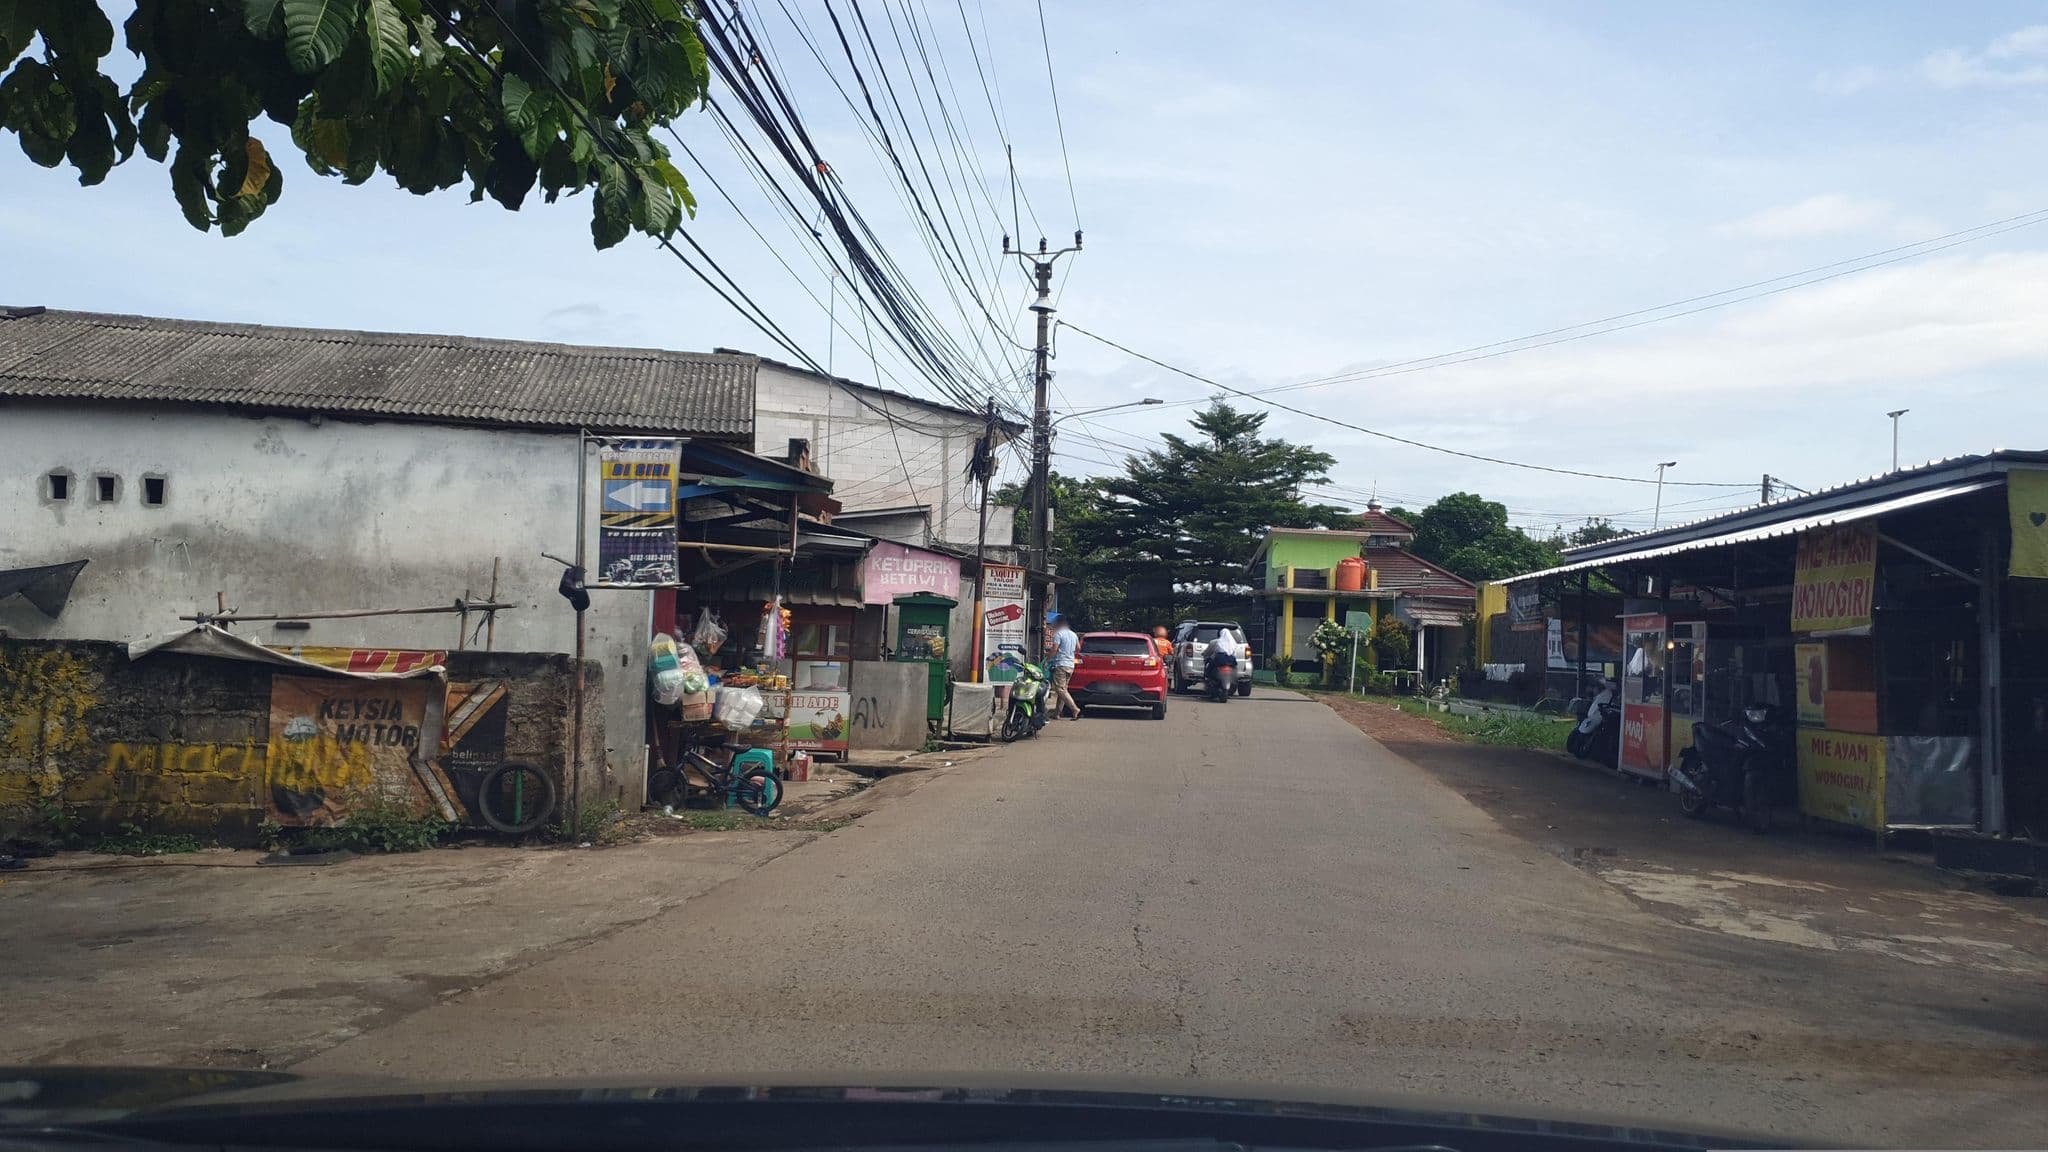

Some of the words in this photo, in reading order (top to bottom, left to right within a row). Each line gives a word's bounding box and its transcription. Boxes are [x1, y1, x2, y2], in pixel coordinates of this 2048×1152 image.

[871, 557, 953, 575] KETOPRAK
[880, 573, 936, 586] BETAWI
[1795, 577, 1871, 619] WONOGIRI
[319, 699, 403, 721] KEYSIA
[773, 696, 804, 708] TH
[807, 697, 839, 709] ADE
[336, 723, 418, 748] MOTOR
[1811, 738, 1831, 757] MIE
[1834, 743, 1868, 762] AYAM
